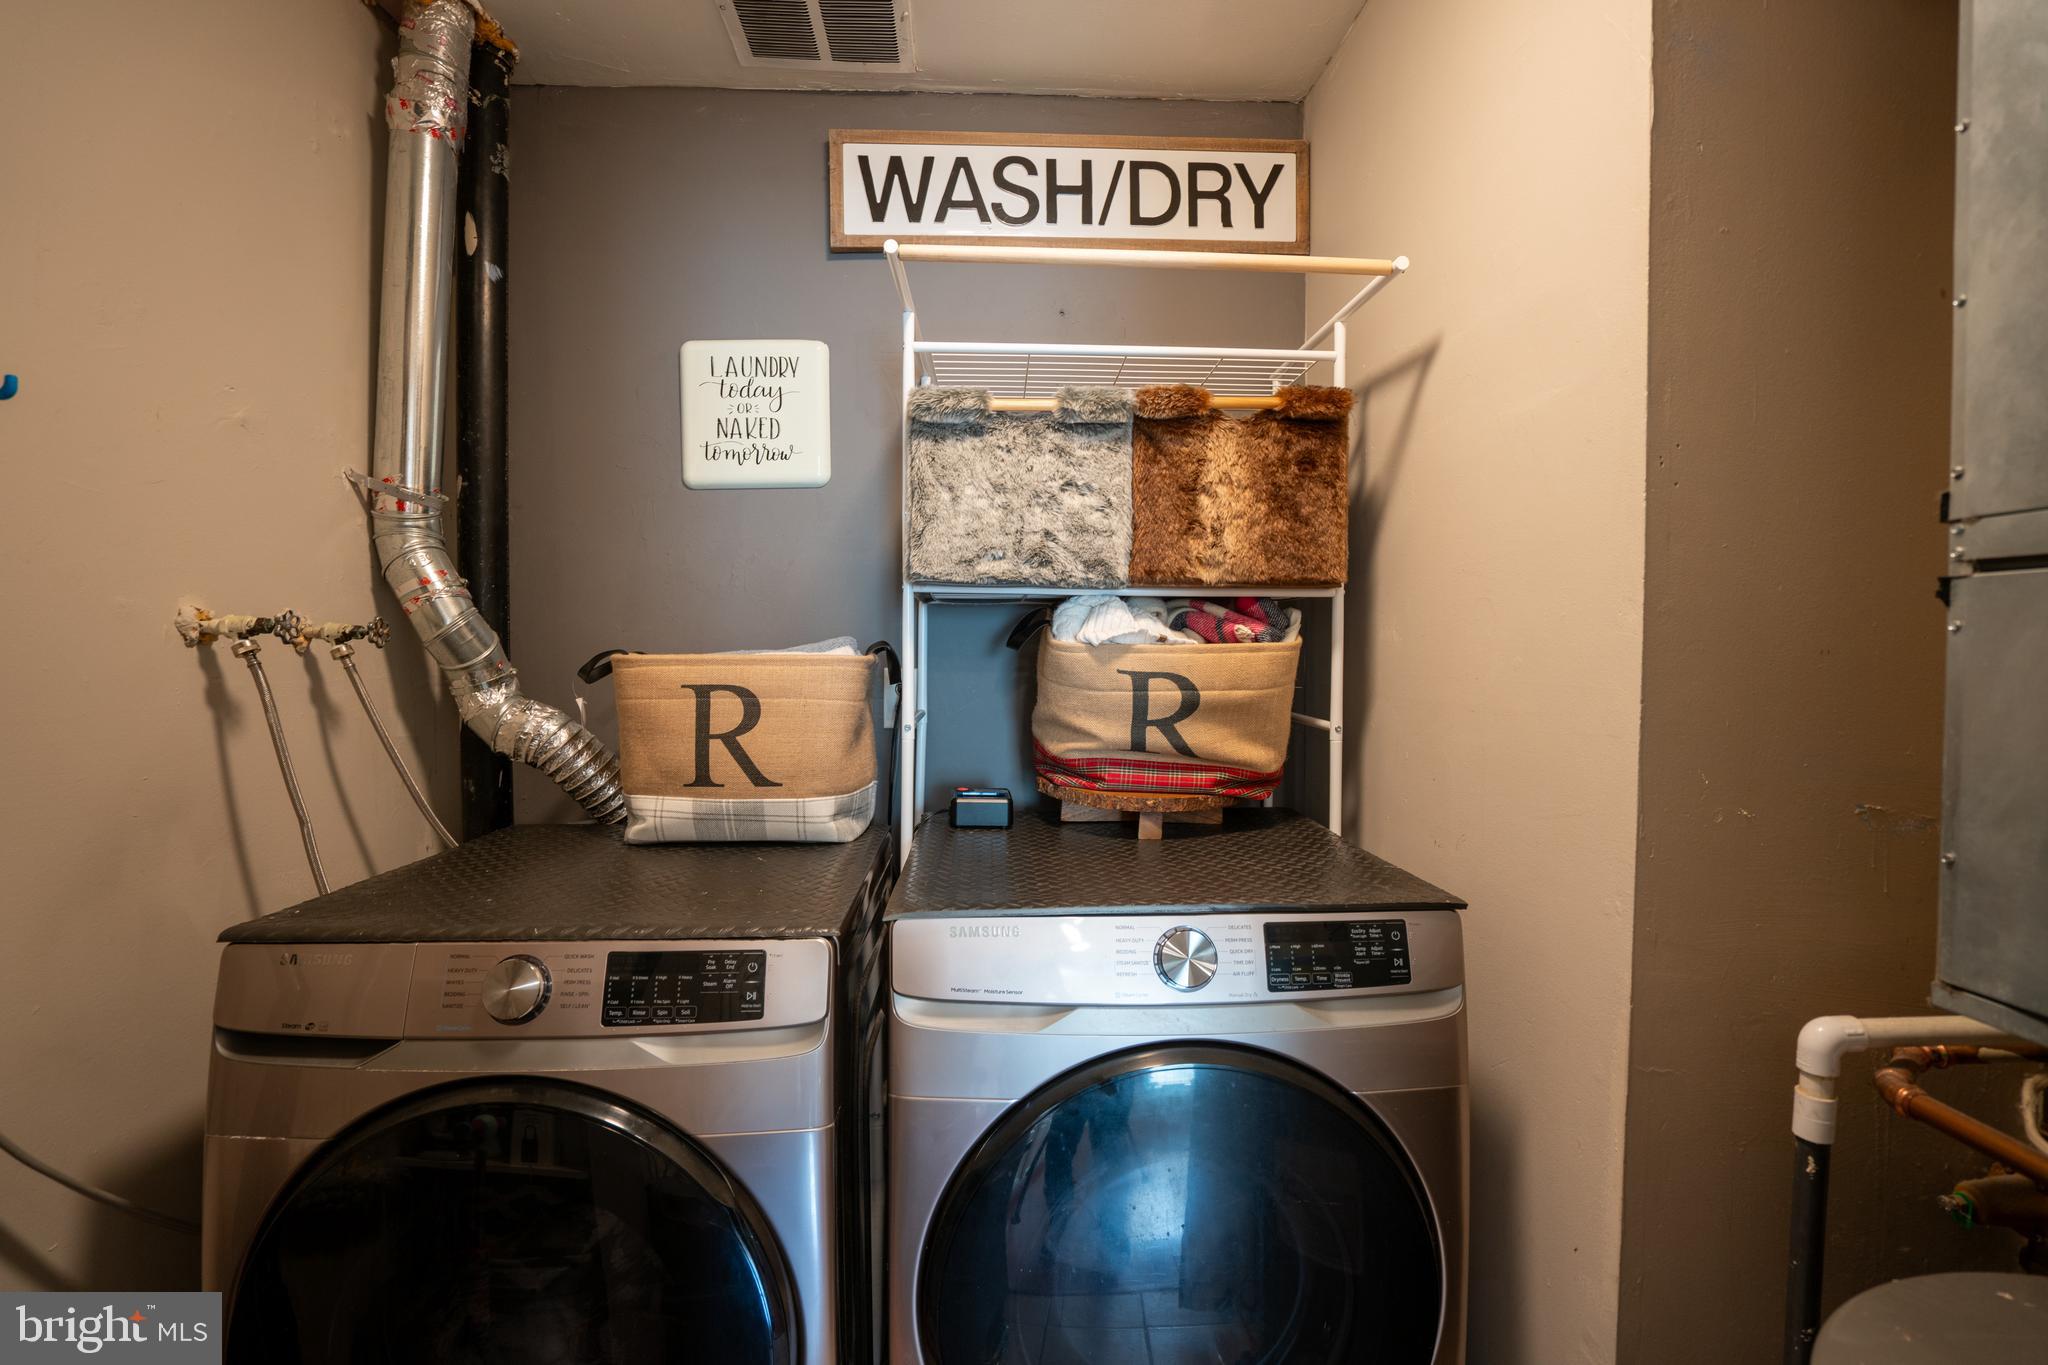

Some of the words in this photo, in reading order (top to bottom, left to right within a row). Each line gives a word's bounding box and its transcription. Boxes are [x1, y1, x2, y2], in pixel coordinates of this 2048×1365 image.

[857, 155, 1285, 229] WASH/DRY
[710, 356, 800, 378] LAUNDRY
[705, 377, 795, 412] today
[737, 403, 753, 413] OR
[716, 417, 781, 439] NAKED
[702, 441, 798, 466] tomorrow
[1117, 670, 1200, 758] R
[681, 684, 783, 788] R
[950, 926, 1020, 938] SAMSUNG
